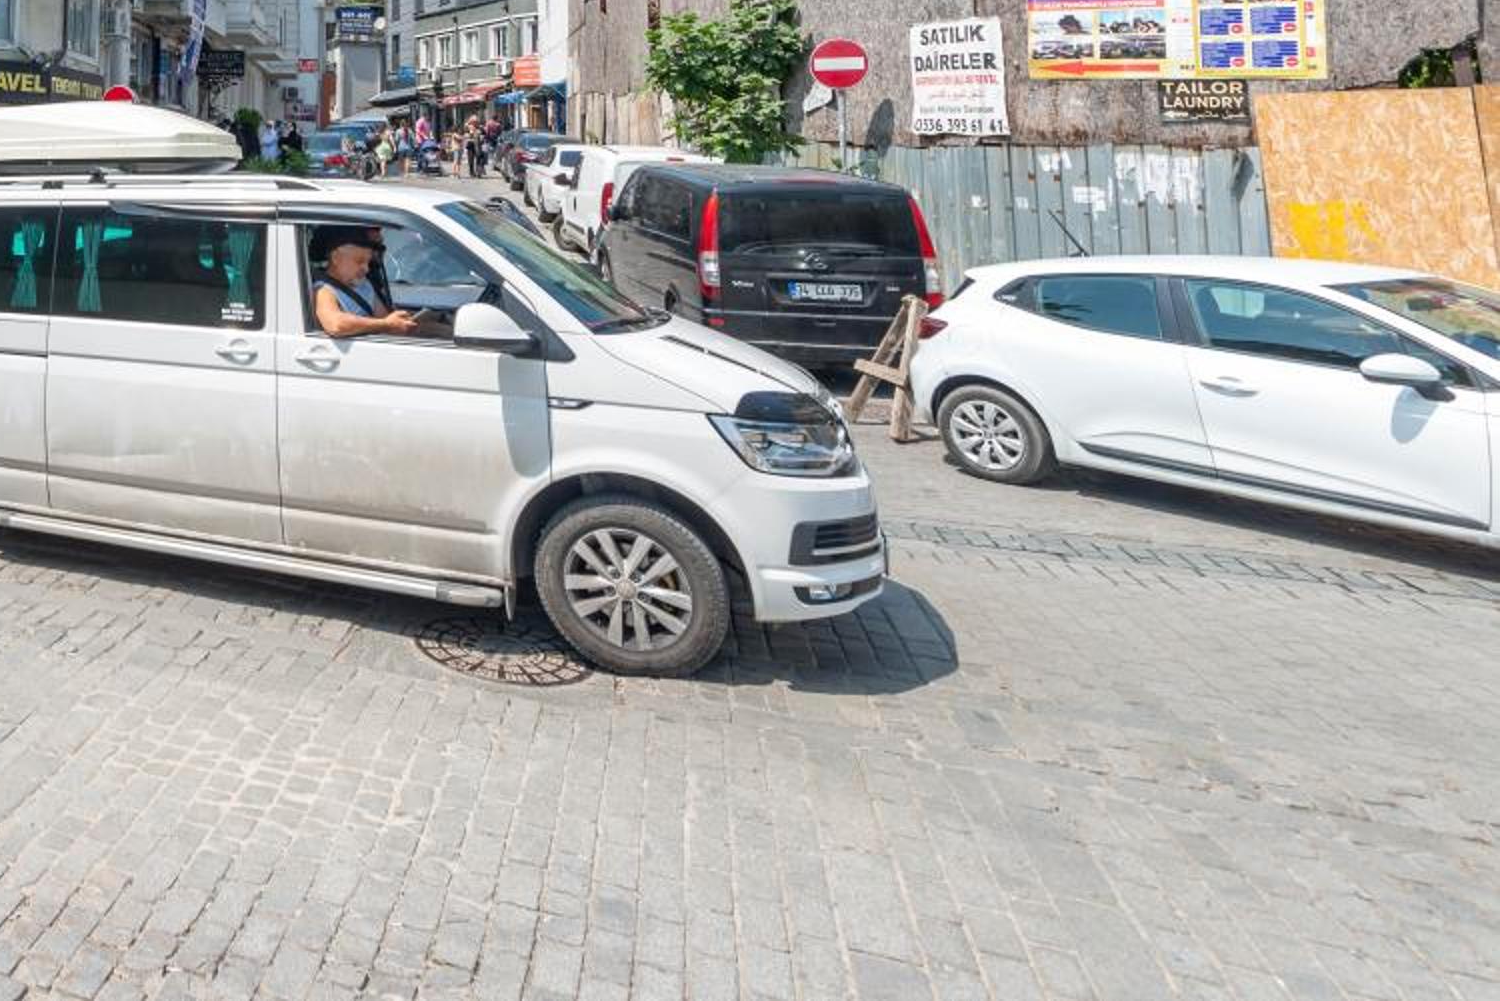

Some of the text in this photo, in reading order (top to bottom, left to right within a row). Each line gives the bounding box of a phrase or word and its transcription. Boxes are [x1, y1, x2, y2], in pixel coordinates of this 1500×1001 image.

[920, 24, 986, 46] SATILIK
[913, 51, 998, 72] DAİRELER
[1161, 81, 1244, 95] TAILOR
[1163, 96, 1245, 109] LAUNDRY
